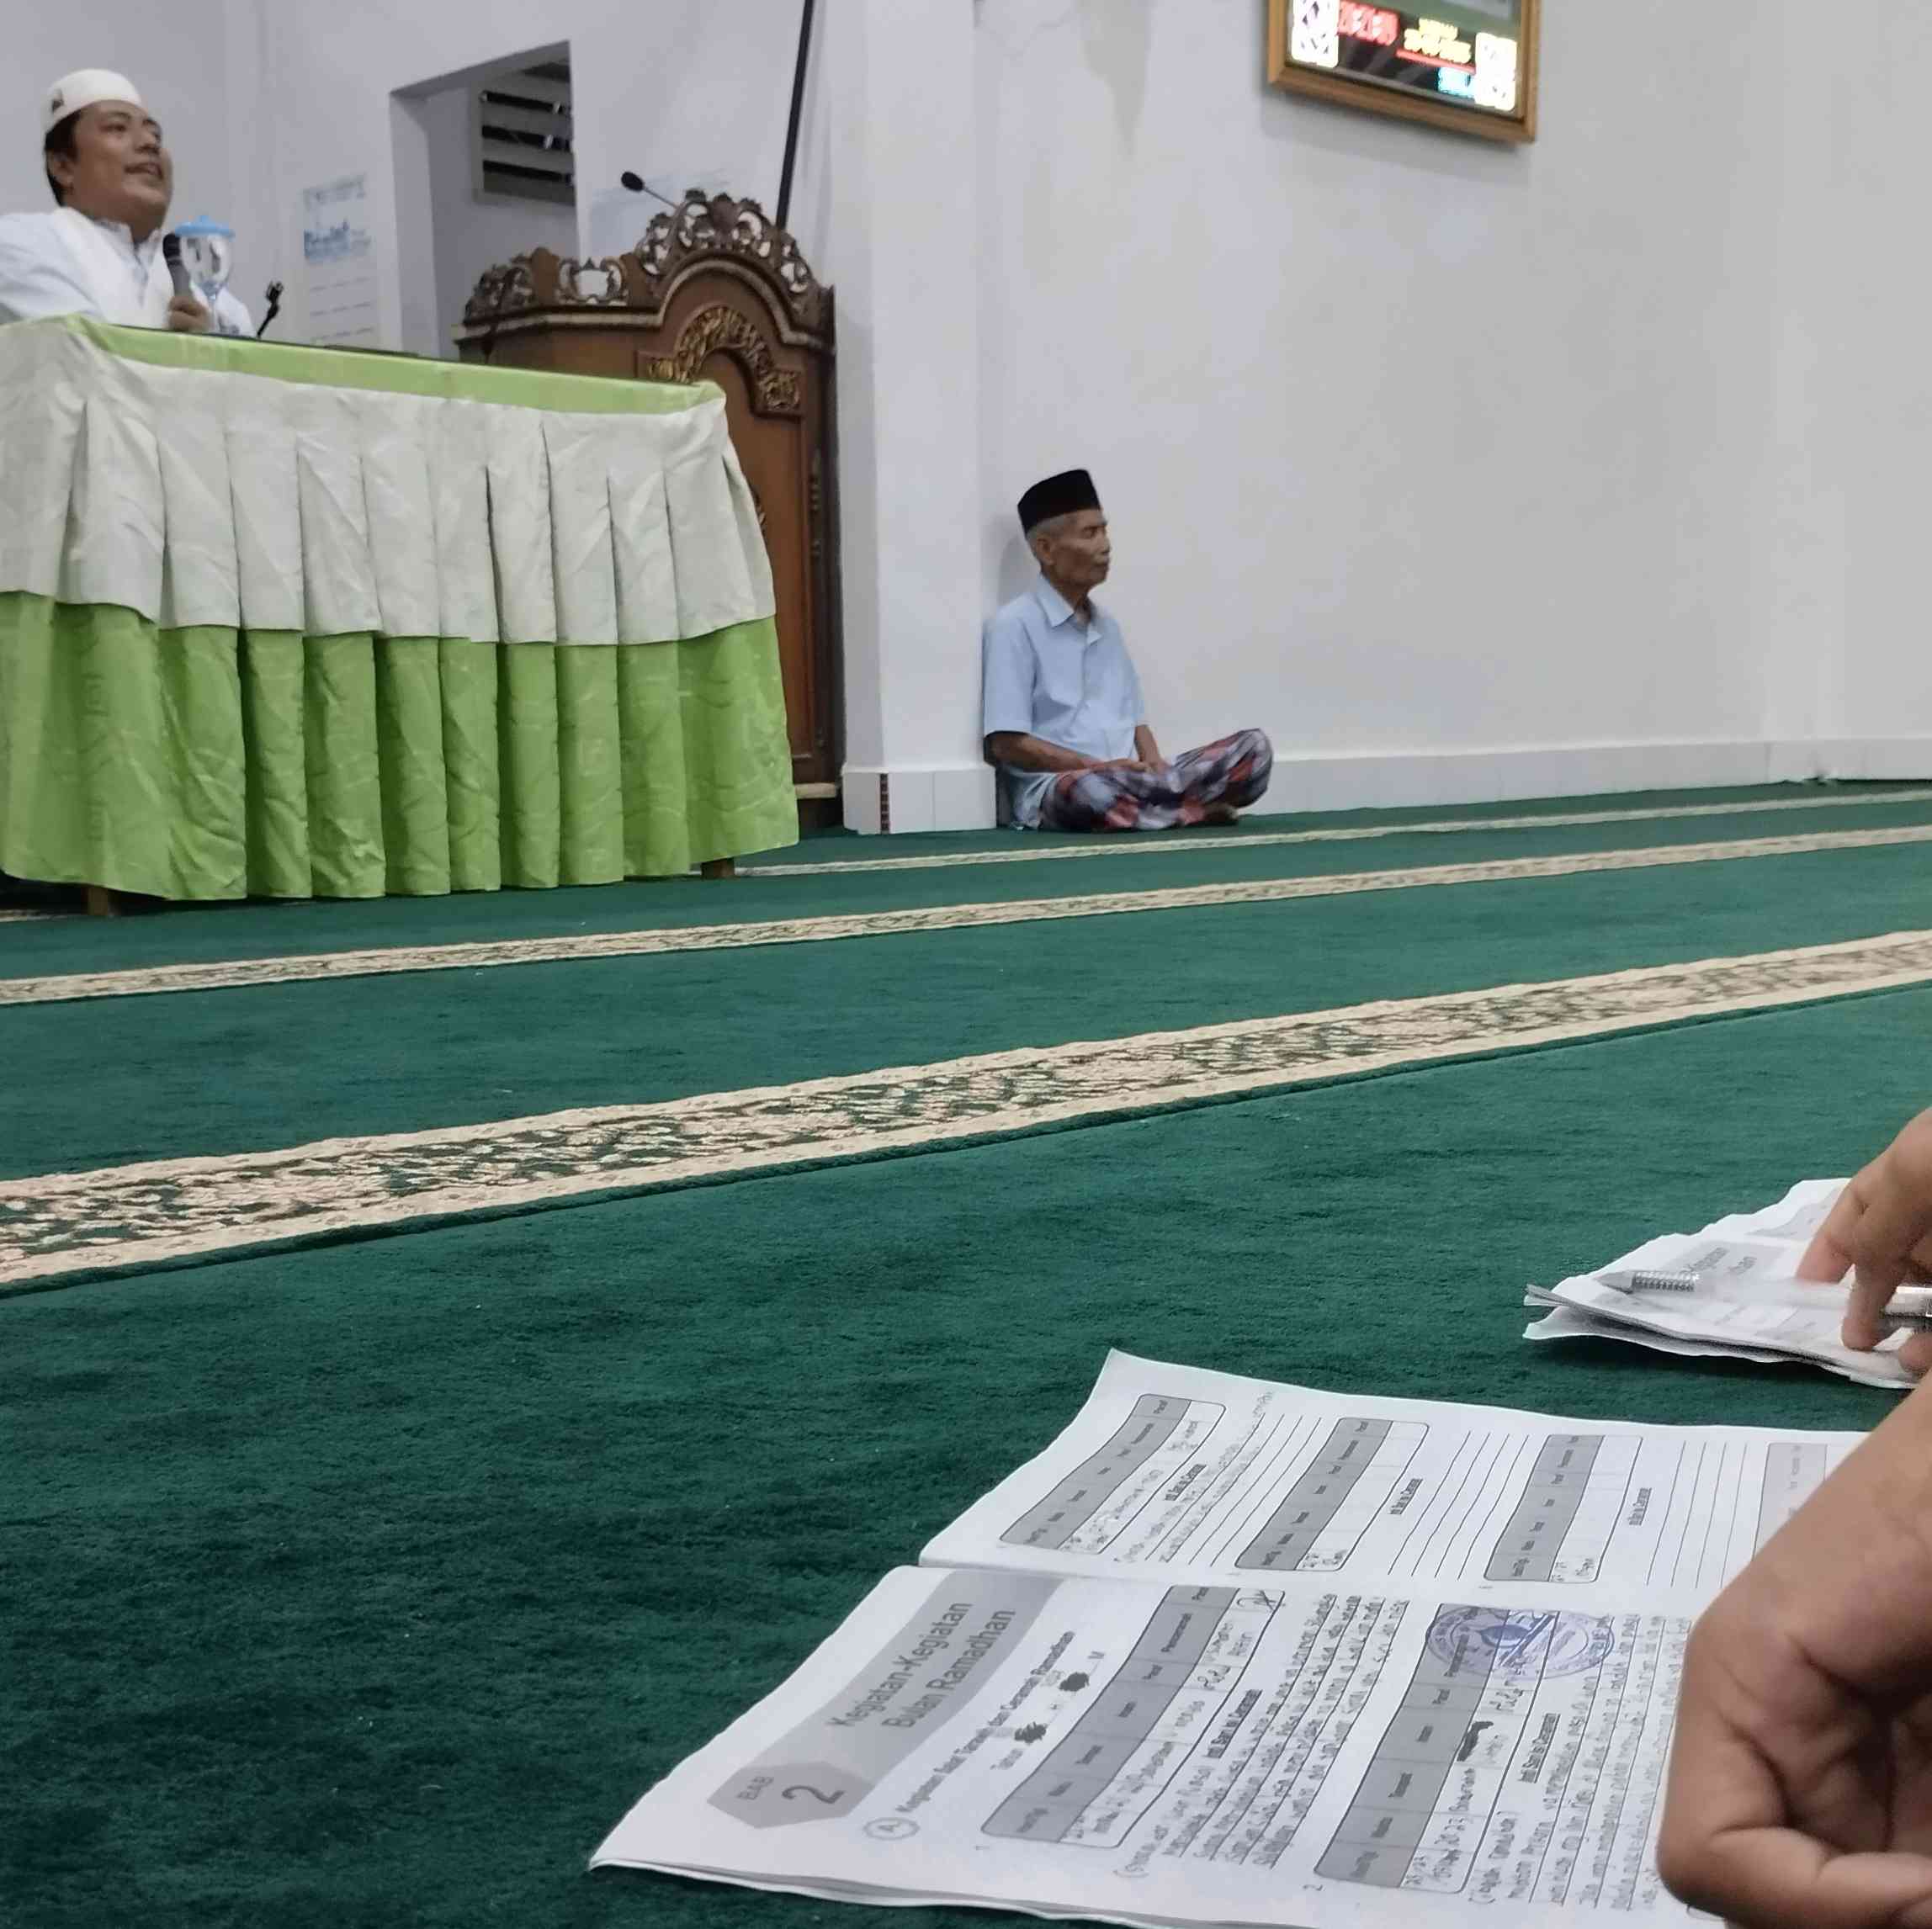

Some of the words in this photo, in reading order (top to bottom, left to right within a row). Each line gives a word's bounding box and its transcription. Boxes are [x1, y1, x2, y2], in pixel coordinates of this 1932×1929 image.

[828, 1602, 973, 1727] Kegiatan-Kegiatan
[881, 1693, 947, 1728] Bulan
[926, 1609, 1016, 1691] Ramadhan
[736, 1776, 775, 1801] BAB
[781, 1784, 845, 1804] 2
